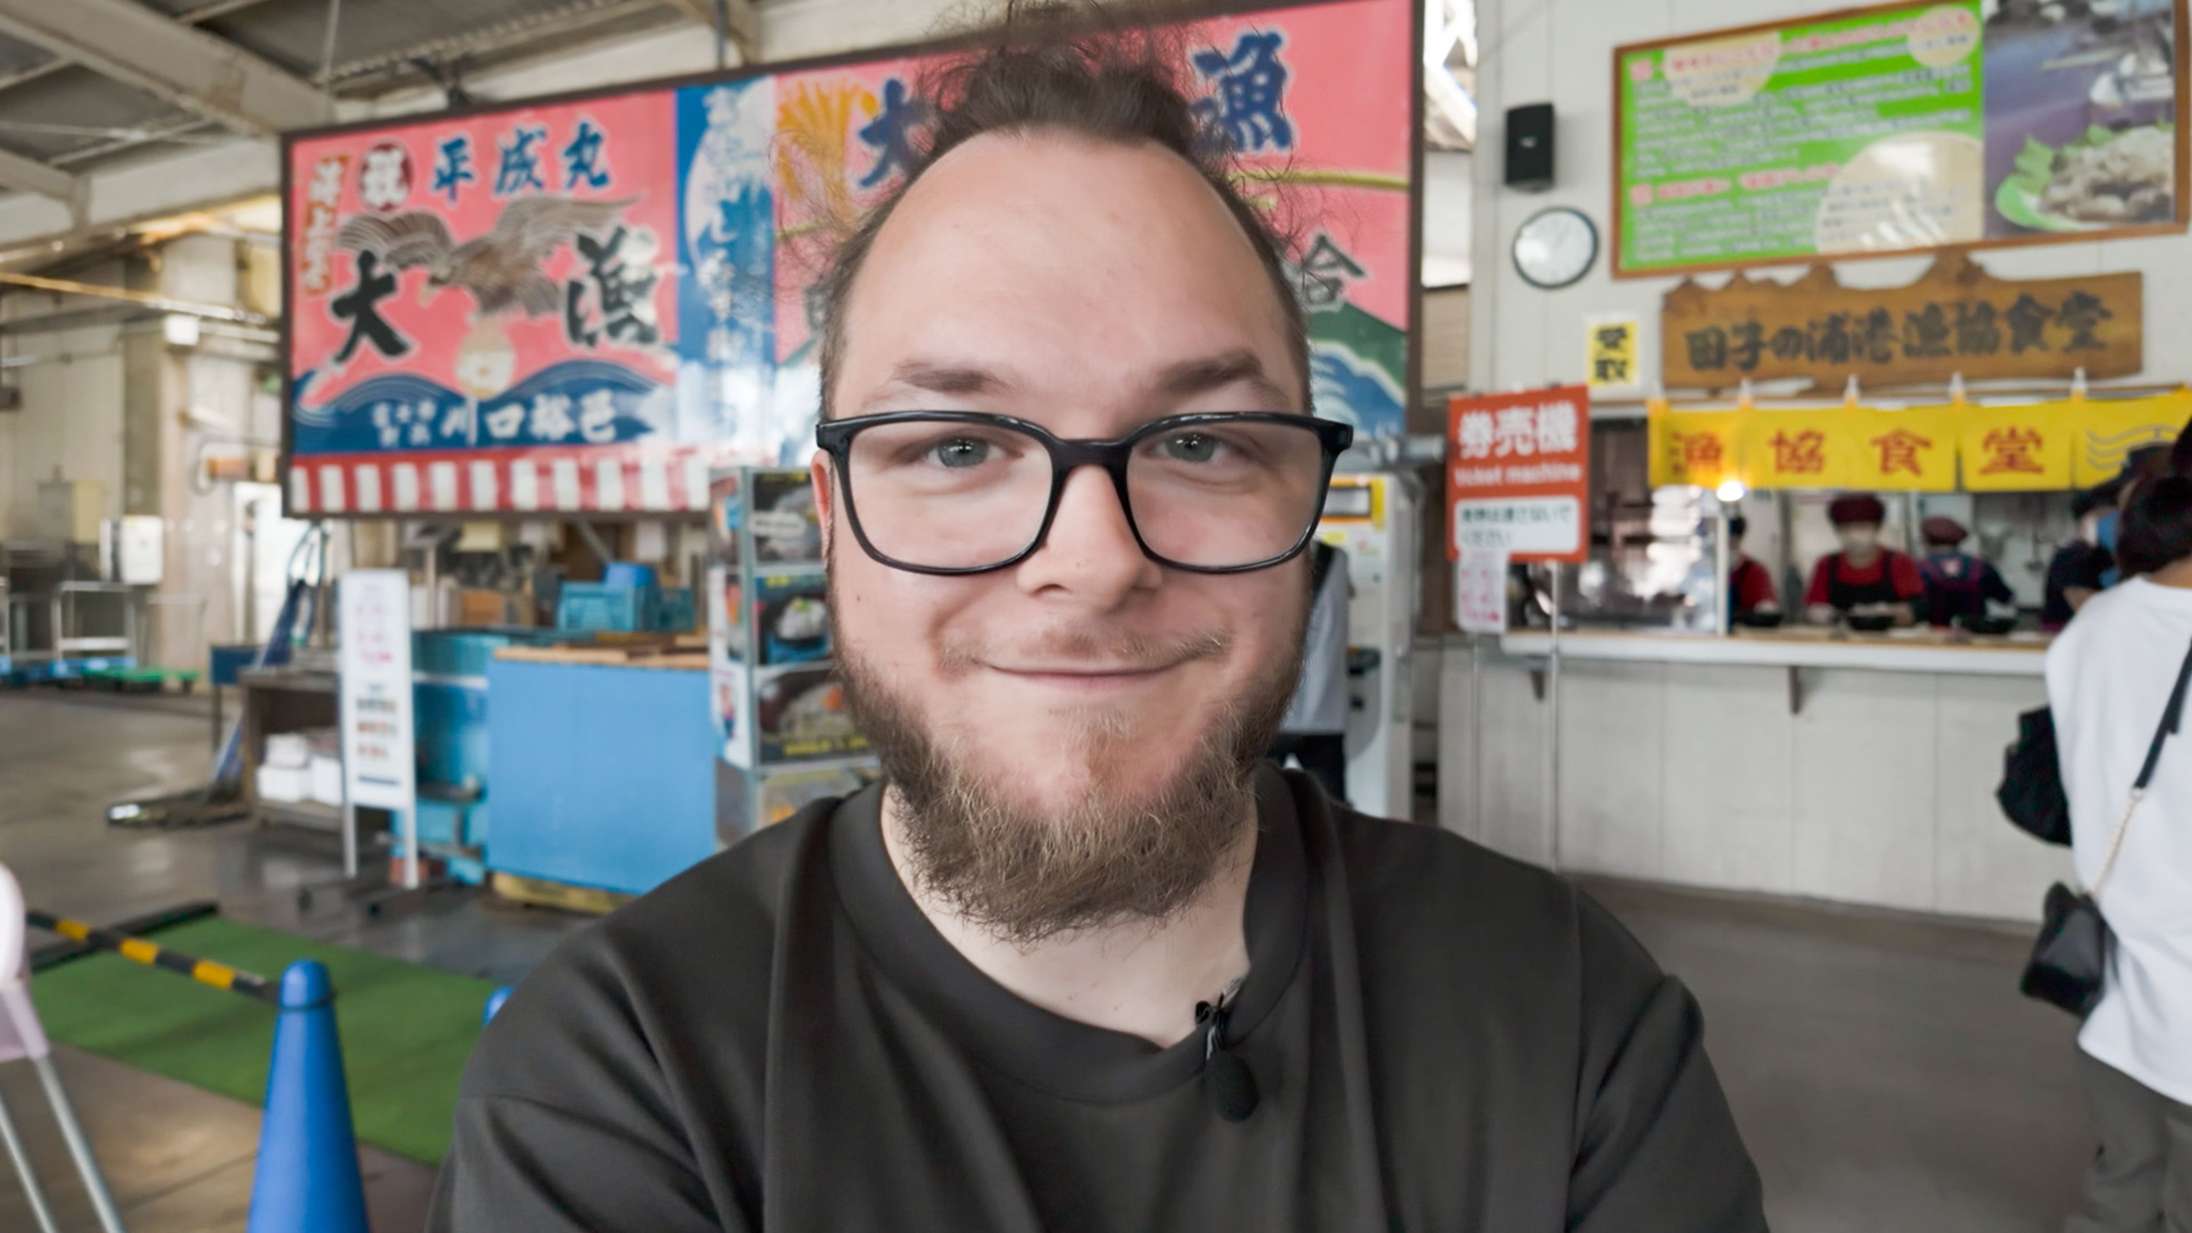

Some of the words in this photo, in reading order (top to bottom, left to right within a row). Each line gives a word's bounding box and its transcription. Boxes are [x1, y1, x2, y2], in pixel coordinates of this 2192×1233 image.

[1190, 31, 1292, 153] 漁
[431, 120, 612, 202] 平成丸
[331, 250, 412, 363] 大
[567, 226, 659, 347] 漁
[1596, 326, 1628, 381] 受取
[1459, 402, 1578, 459] 券売機
[1672, 425, 2045, 477] 漁協食堂
[1507, 462, 1581, 486] machine
